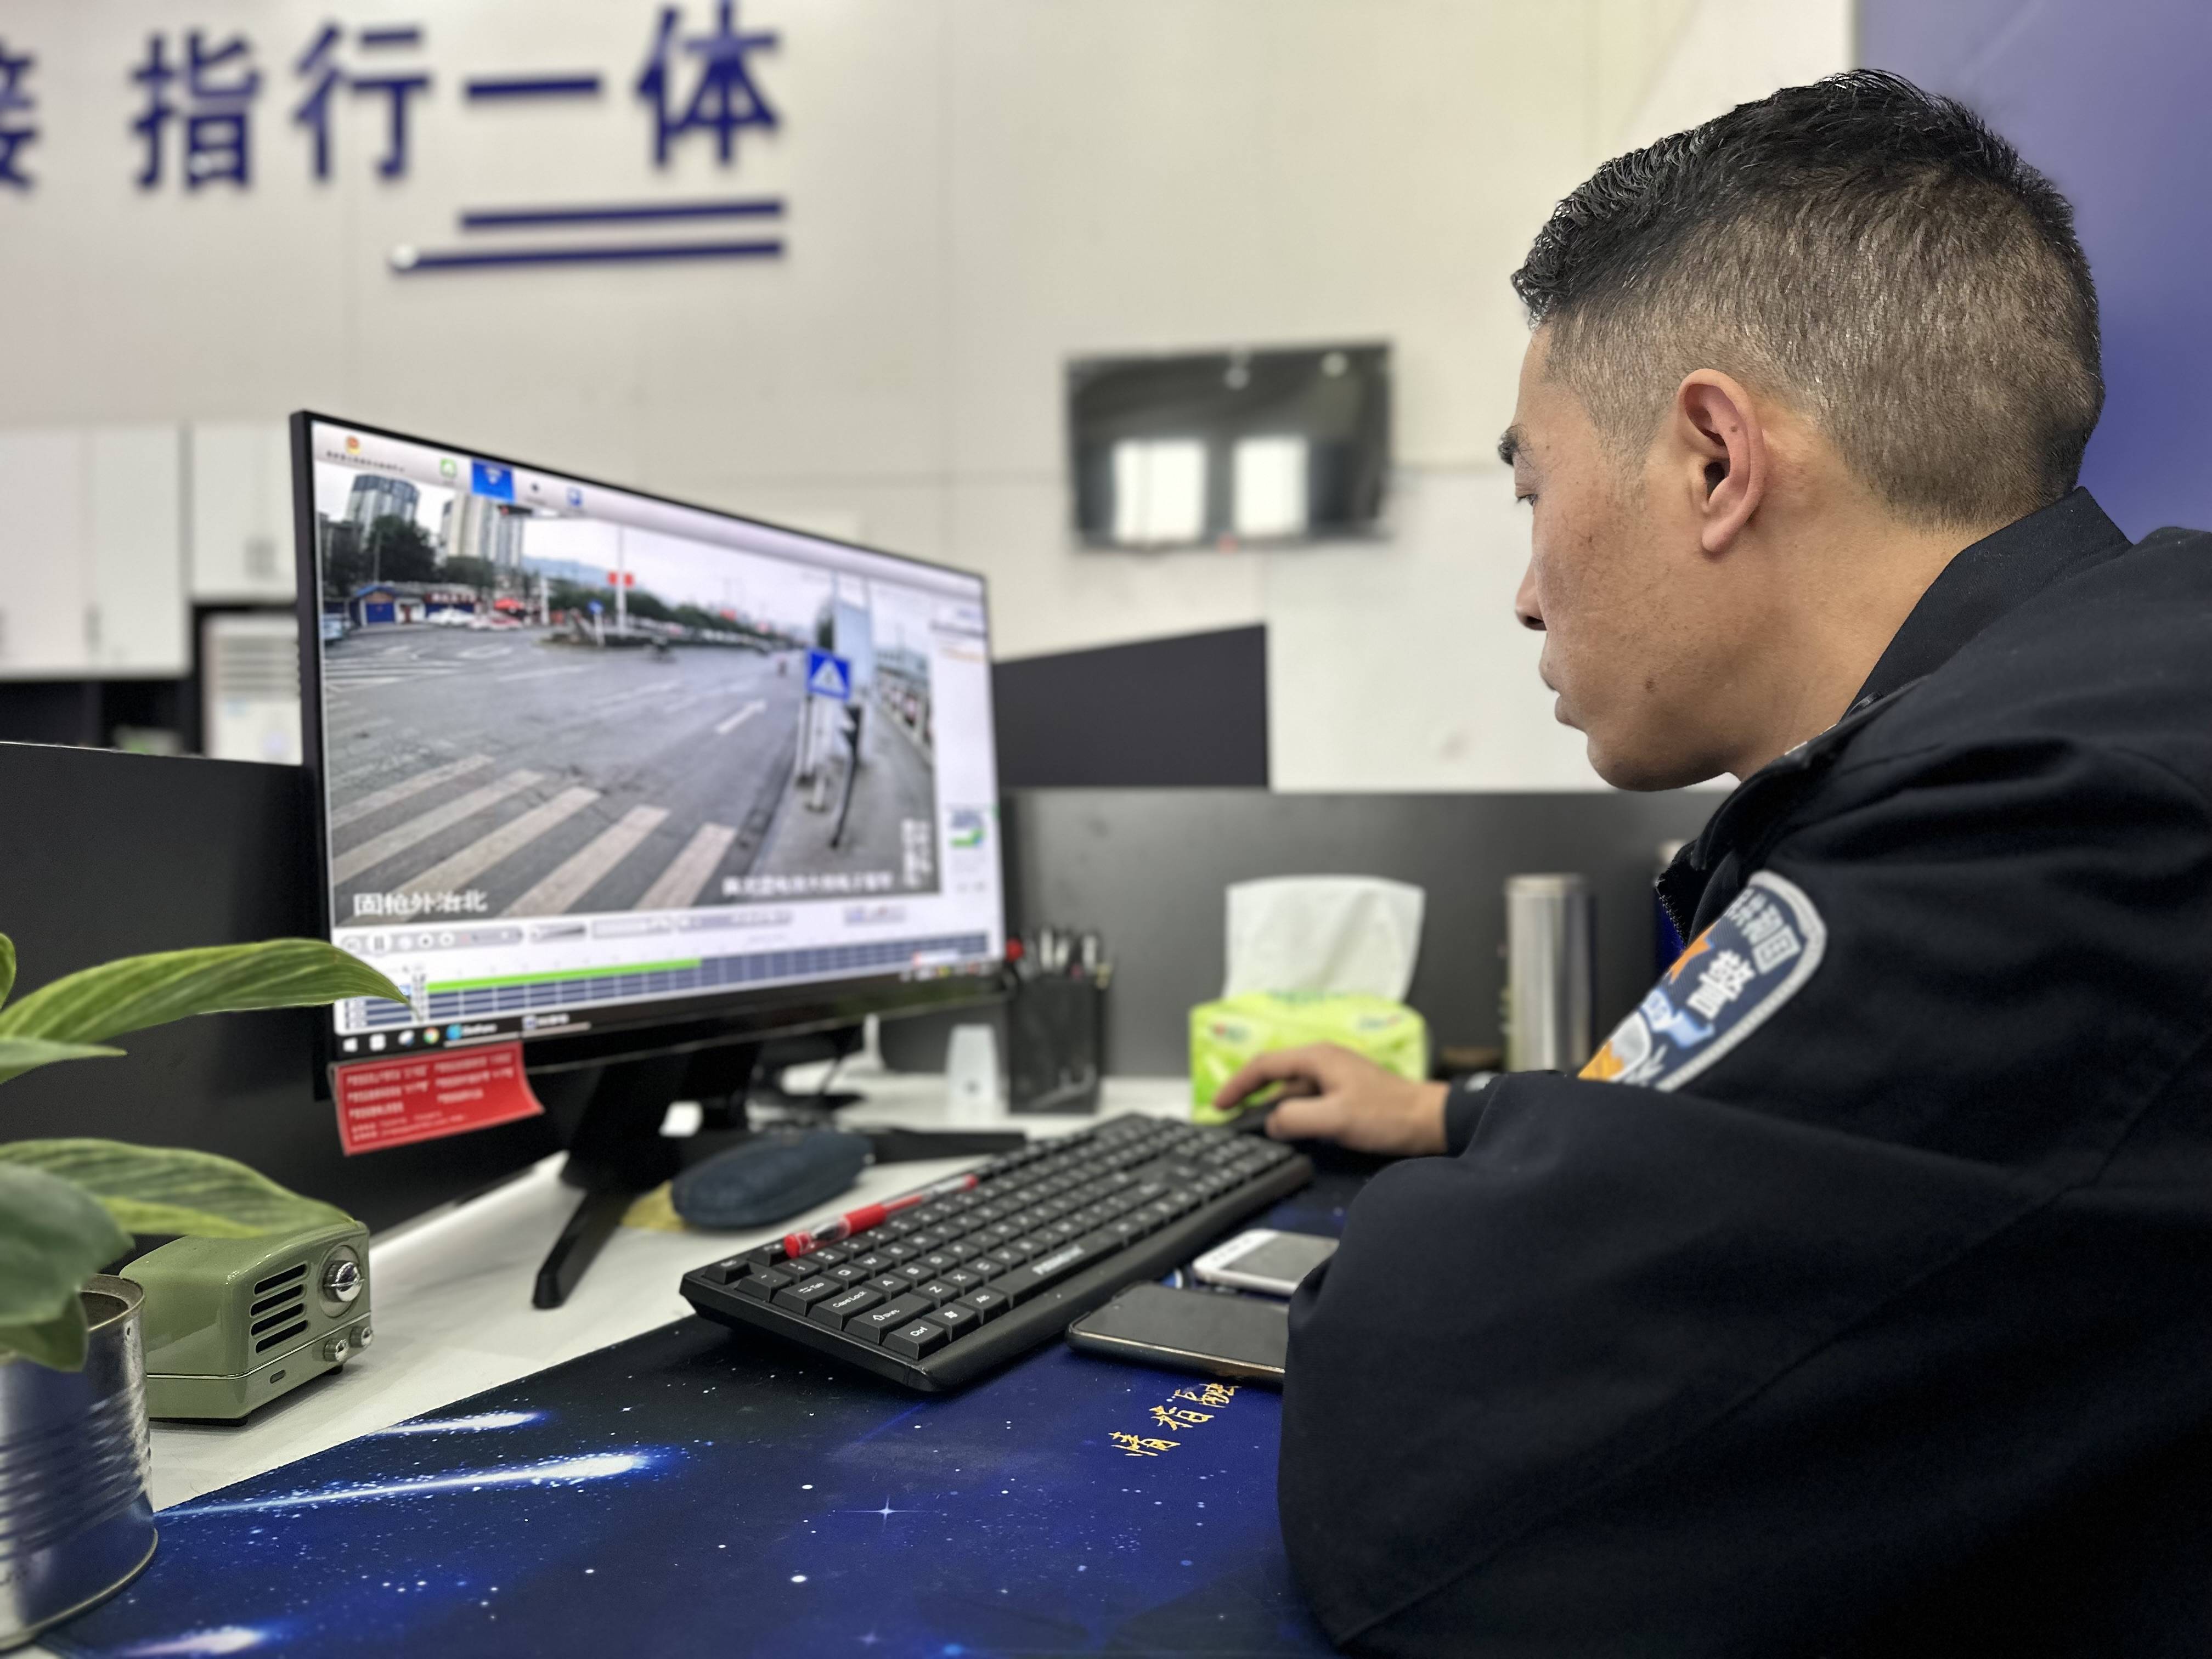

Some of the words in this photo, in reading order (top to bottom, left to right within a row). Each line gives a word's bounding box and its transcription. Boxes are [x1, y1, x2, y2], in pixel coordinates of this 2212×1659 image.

[129, 0, 783, 191] 指行一体
[1686, 950, 1754, 1019] 警
[910, 1326, 928, 1336] Ctrl
